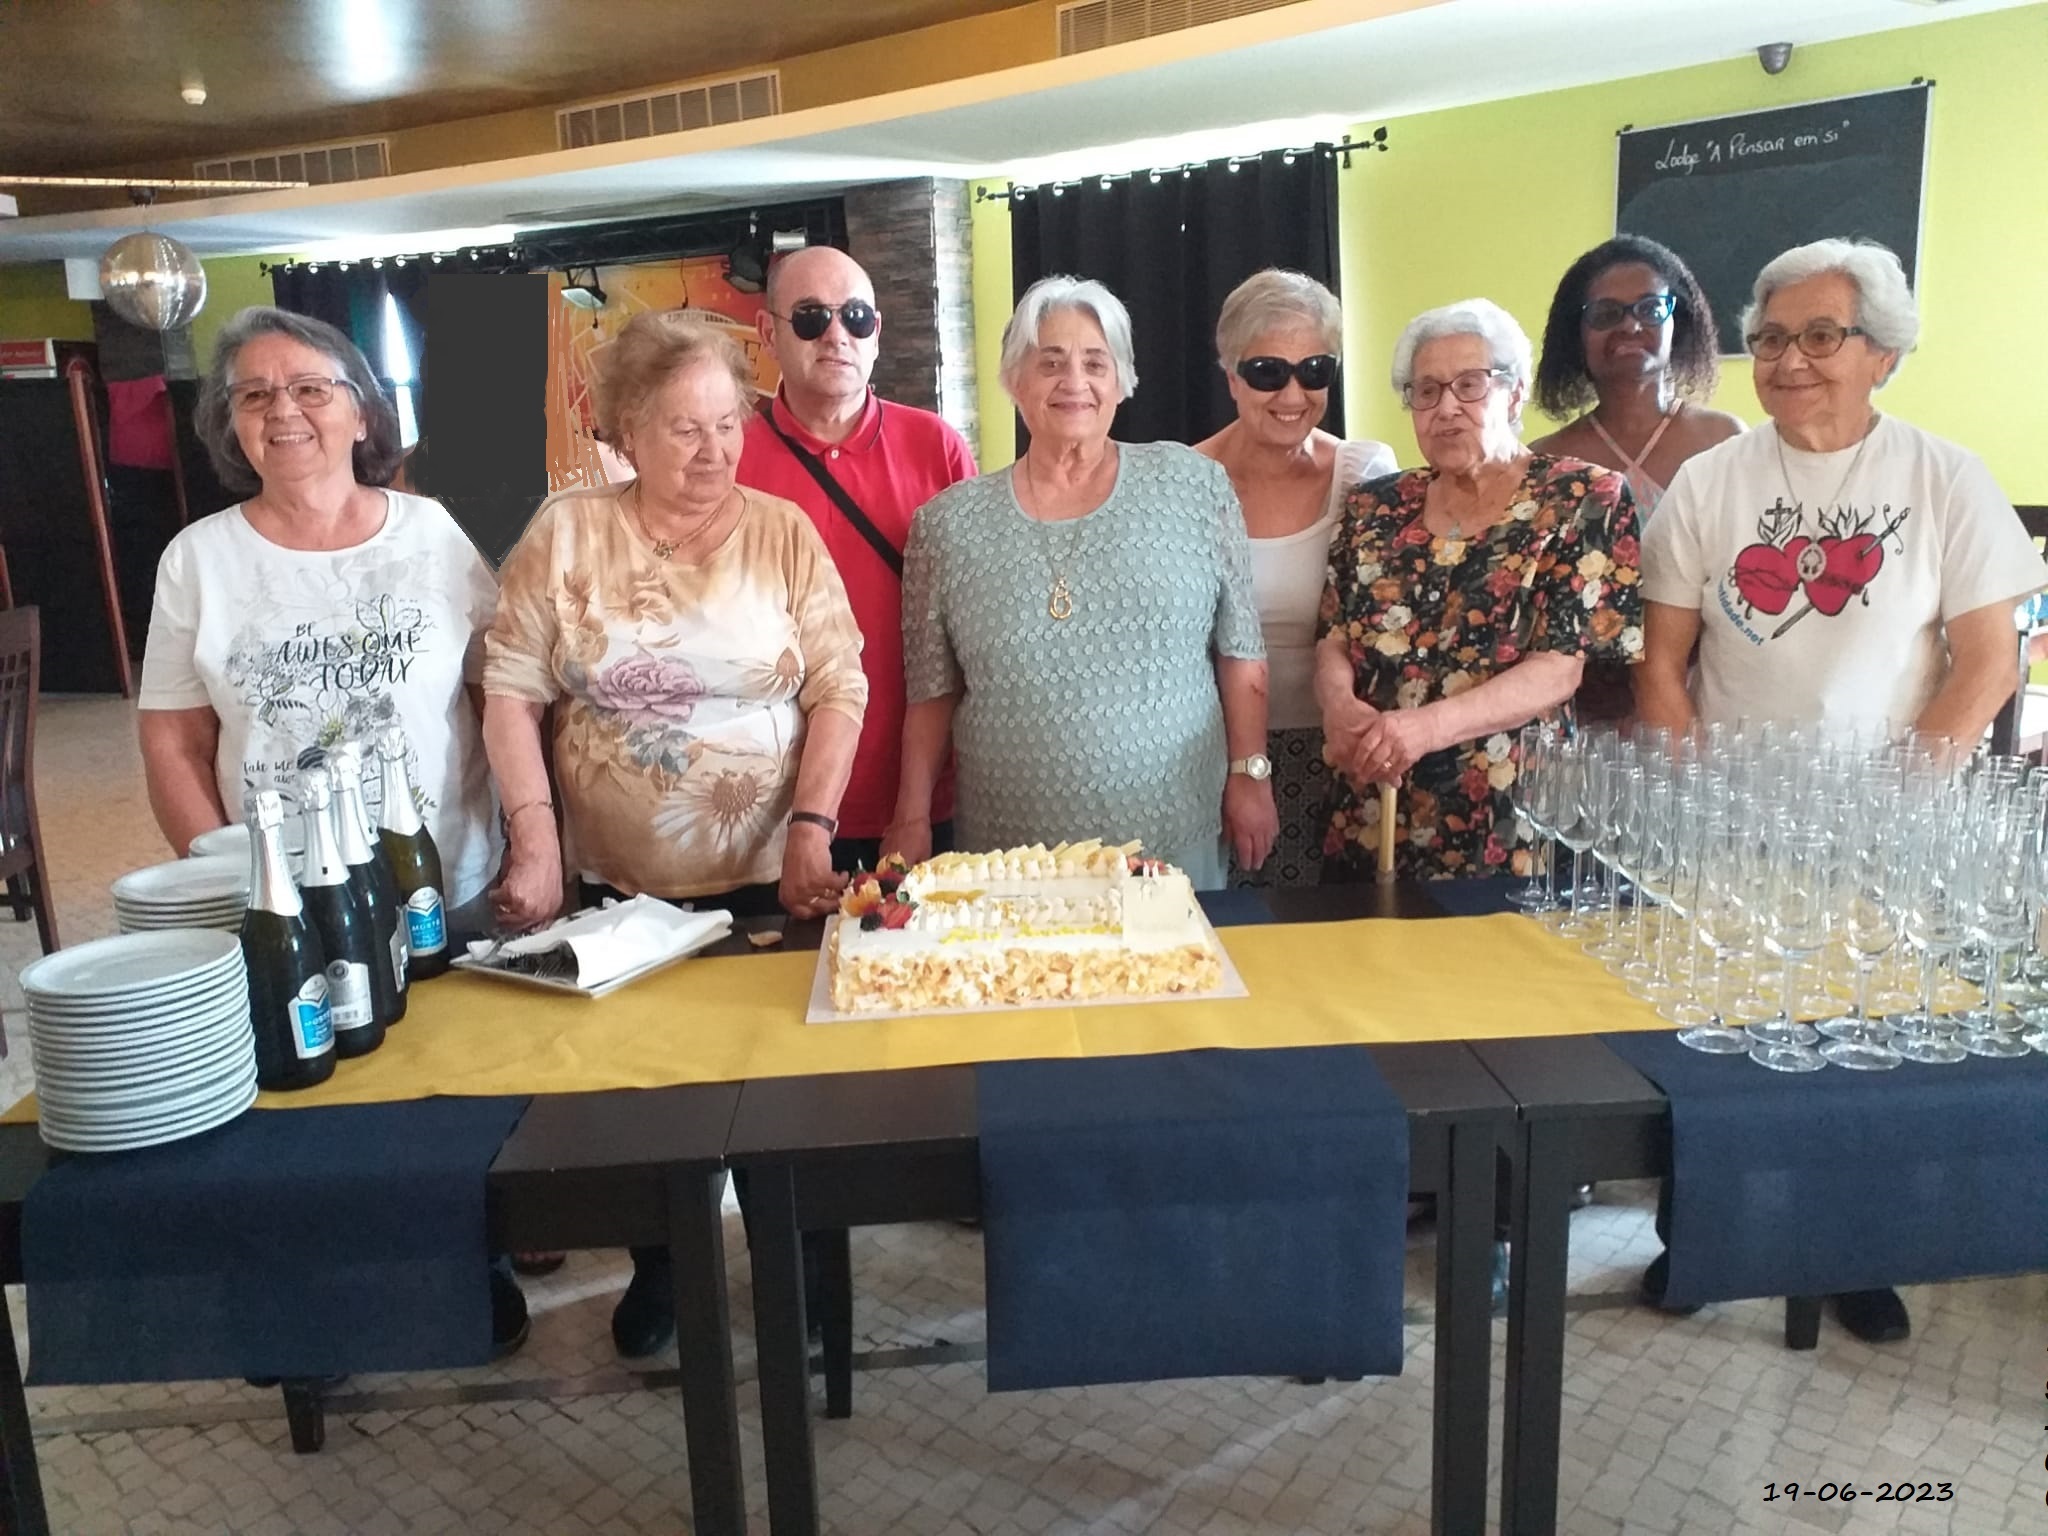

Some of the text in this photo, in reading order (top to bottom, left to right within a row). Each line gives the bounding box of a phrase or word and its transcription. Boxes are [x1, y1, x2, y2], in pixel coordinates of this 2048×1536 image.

[1794, 136, 1818, 147] em
[296, 621, 318, 638] BE
[275, 630, 428, 664] AWESOME
[314, 656, 414, 692] TODAY
